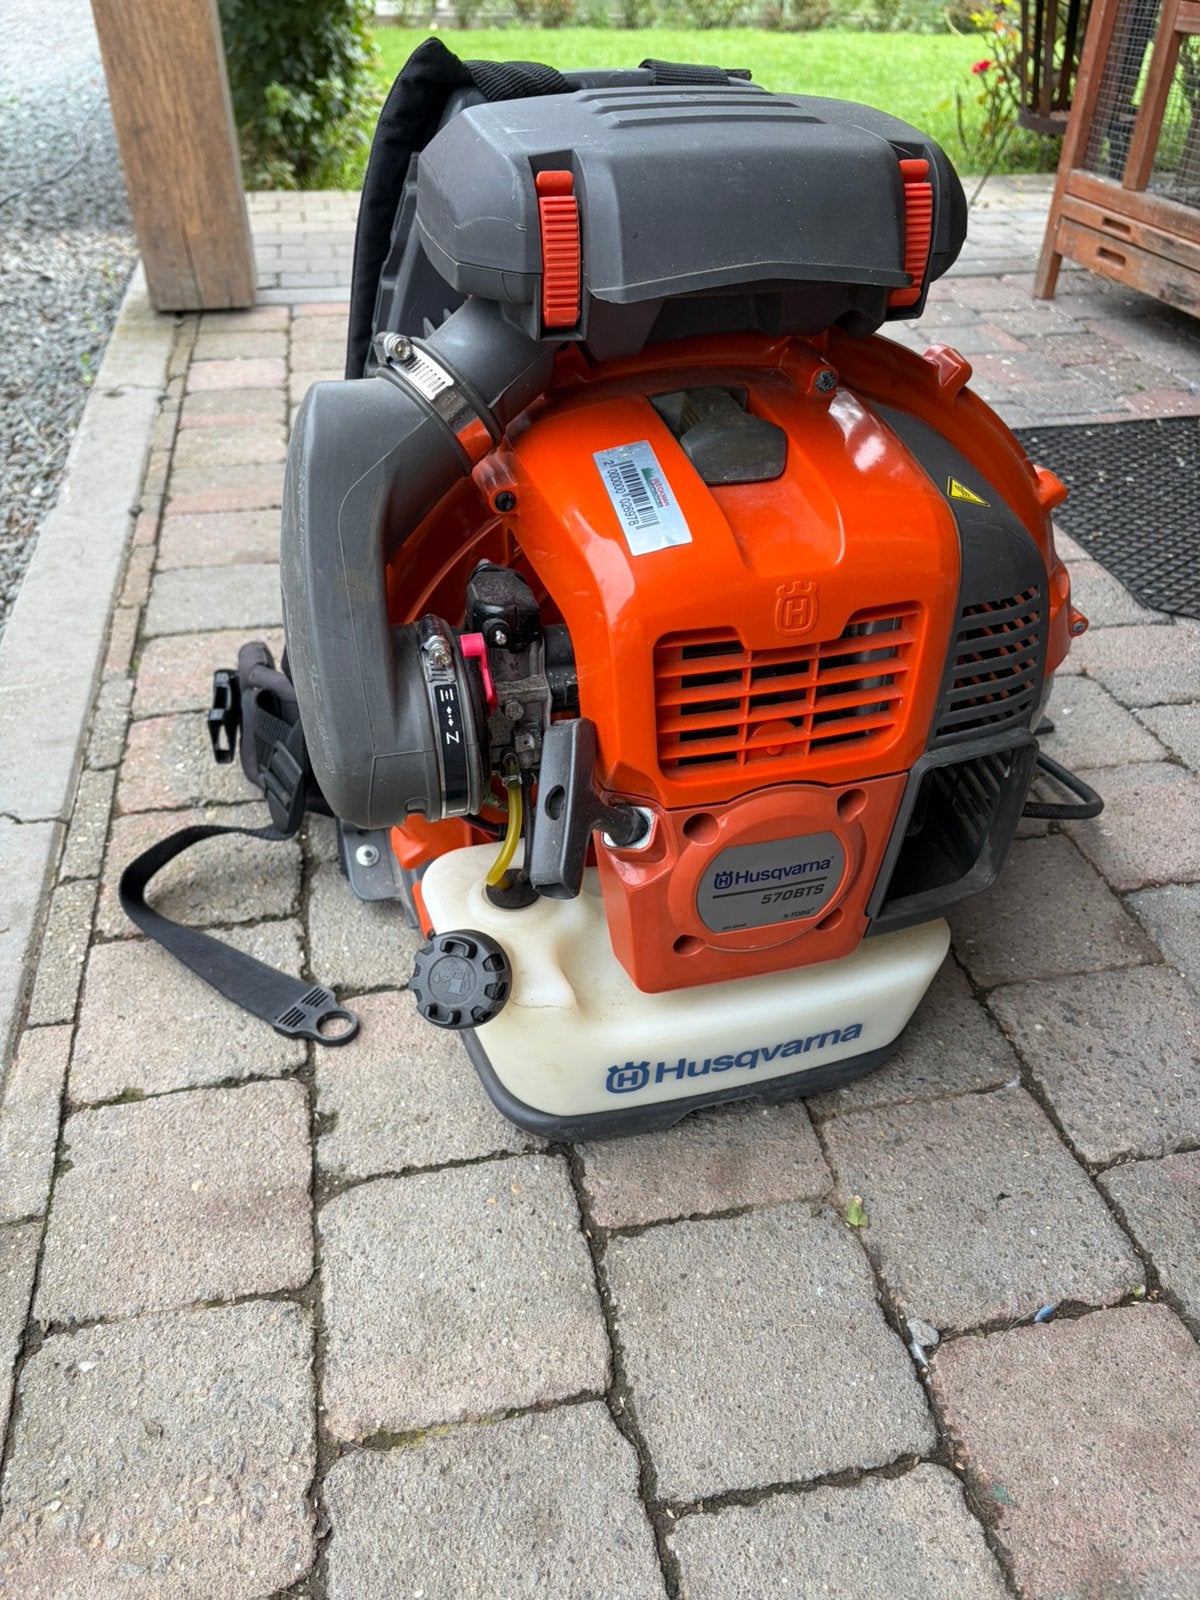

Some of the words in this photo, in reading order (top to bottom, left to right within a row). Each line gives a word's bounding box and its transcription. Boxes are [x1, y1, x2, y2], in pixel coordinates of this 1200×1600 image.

[607, 468, 626, 494] 000000
[620, 497, 640, 526] 026978
[735, 858, 831, 885] Husqvarna
[761, 883, 826, 905] 570BTS
[655, 1022, 864, 1084] Husqvarna
